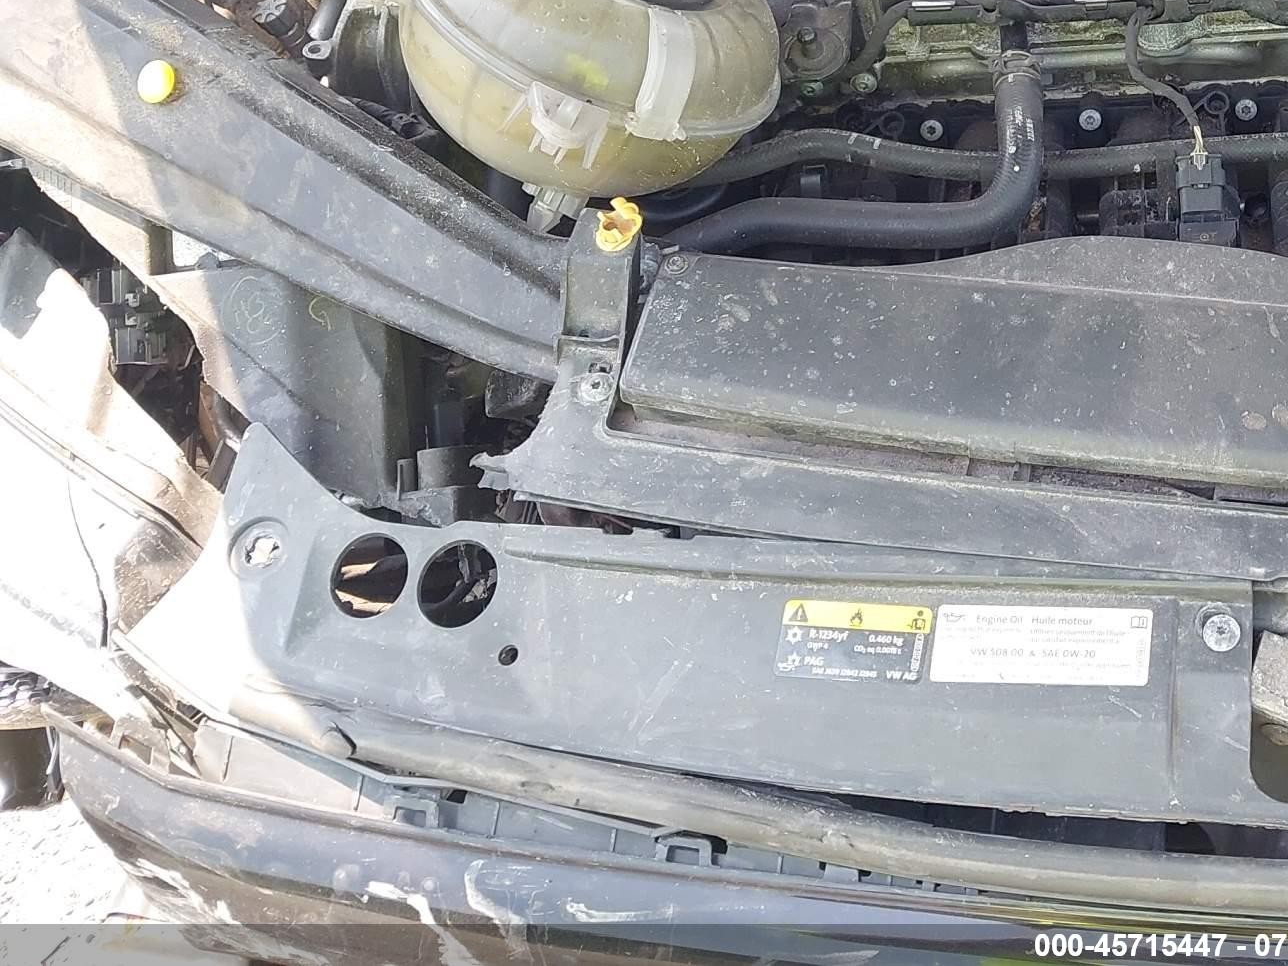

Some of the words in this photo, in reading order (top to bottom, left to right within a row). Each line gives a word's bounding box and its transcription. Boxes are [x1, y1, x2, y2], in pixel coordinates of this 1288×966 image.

[976, 615, 1008, 625] Engine
[1010, 615, 1024, 624] Oil
[1031, 616, 1056, 625] Huile
[1058, 617, 1093, 626] moteur
[809, 629, 848, 642] R-1234yf
[869, 635, 892, 643] 0.460
[893, 636, 905, 646] kg
[970, 648, 987, 657] VW
[990, 648, 1008, 657] 508
[1011, 649, 1024, 657] 00
[1042, 649, 1060, 658] SAE
[1062, 650, 1096, 658] 0W-20
[804, 656, 825, 666] PAG
[886, 670, 902, 679] VW
[902, 671, 918, 681] AG
